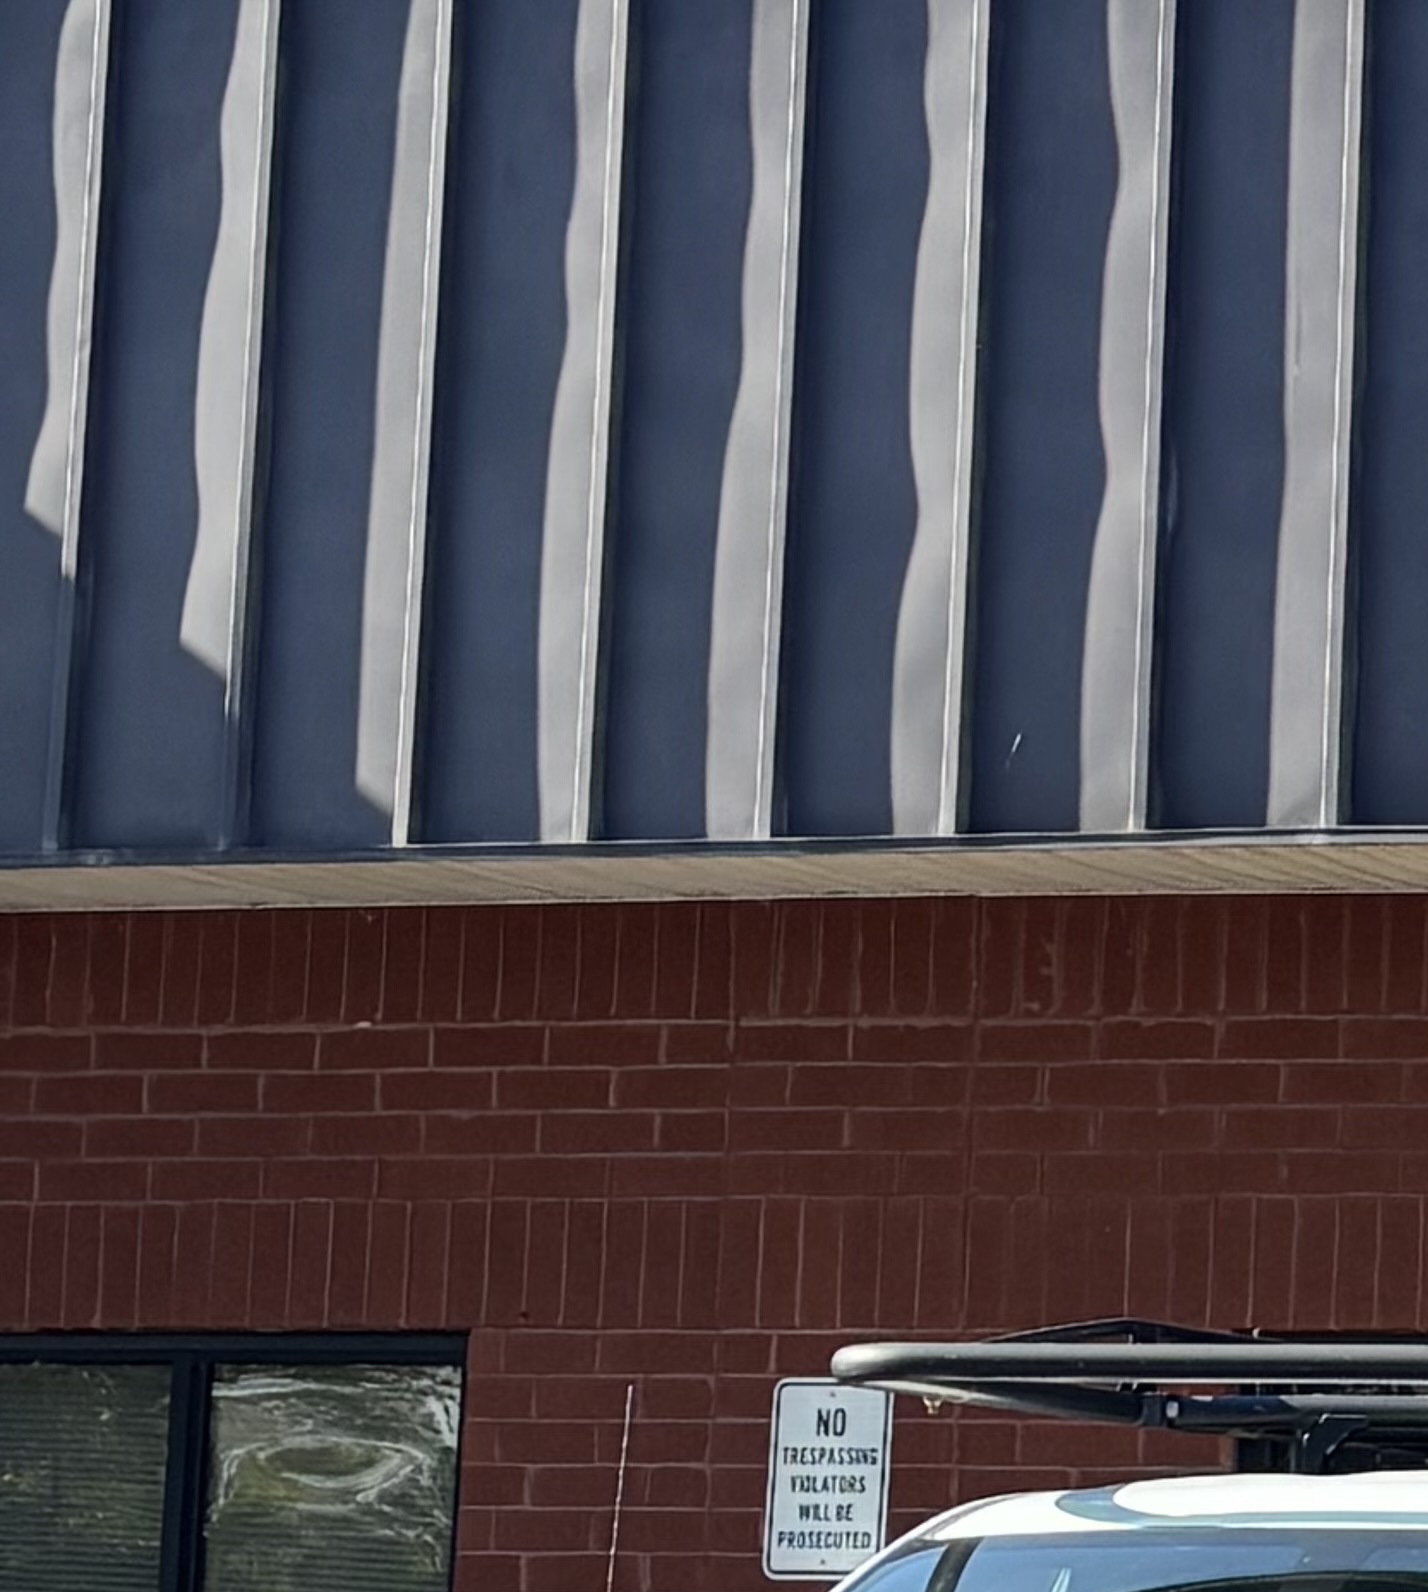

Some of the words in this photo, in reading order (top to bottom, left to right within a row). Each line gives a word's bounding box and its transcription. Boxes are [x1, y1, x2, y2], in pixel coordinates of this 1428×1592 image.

[816, 1407, 847, 1438] NO
[782, 1446, 879, 1466] TRESPASSING
[790, 1475, 867, 1494] VIOLATORS
[798, 1503, 832, 1522] WILL
[835, 1503, 854, 1522] BE
[777, 1530, 872, 1550] PROSECUTED
